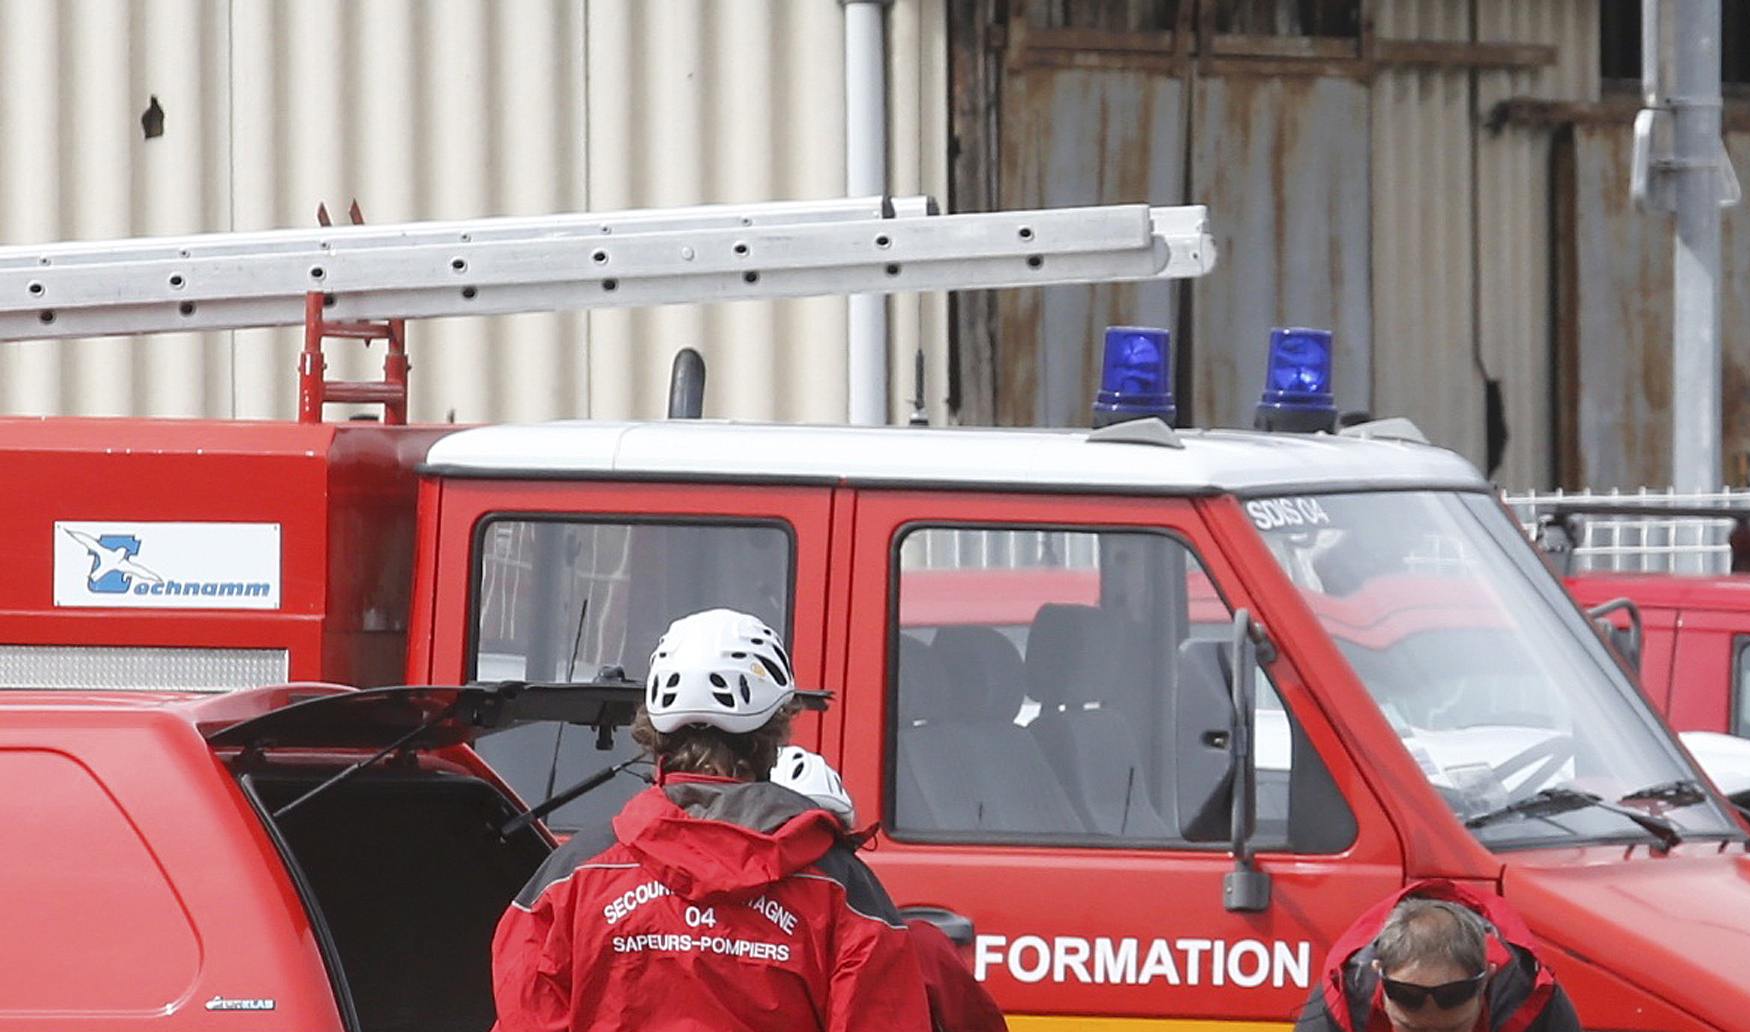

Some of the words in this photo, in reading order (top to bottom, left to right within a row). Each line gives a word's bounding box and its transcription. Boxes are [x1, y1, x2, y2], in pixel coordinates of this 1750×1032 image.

[603, 880, 675, 925] SECOUR
[685, 906, 716, 929] 04
[612, 934, 790, 962] SAPEURS-POMPIERS
[973, 935, 1310, 989] FORMATION
